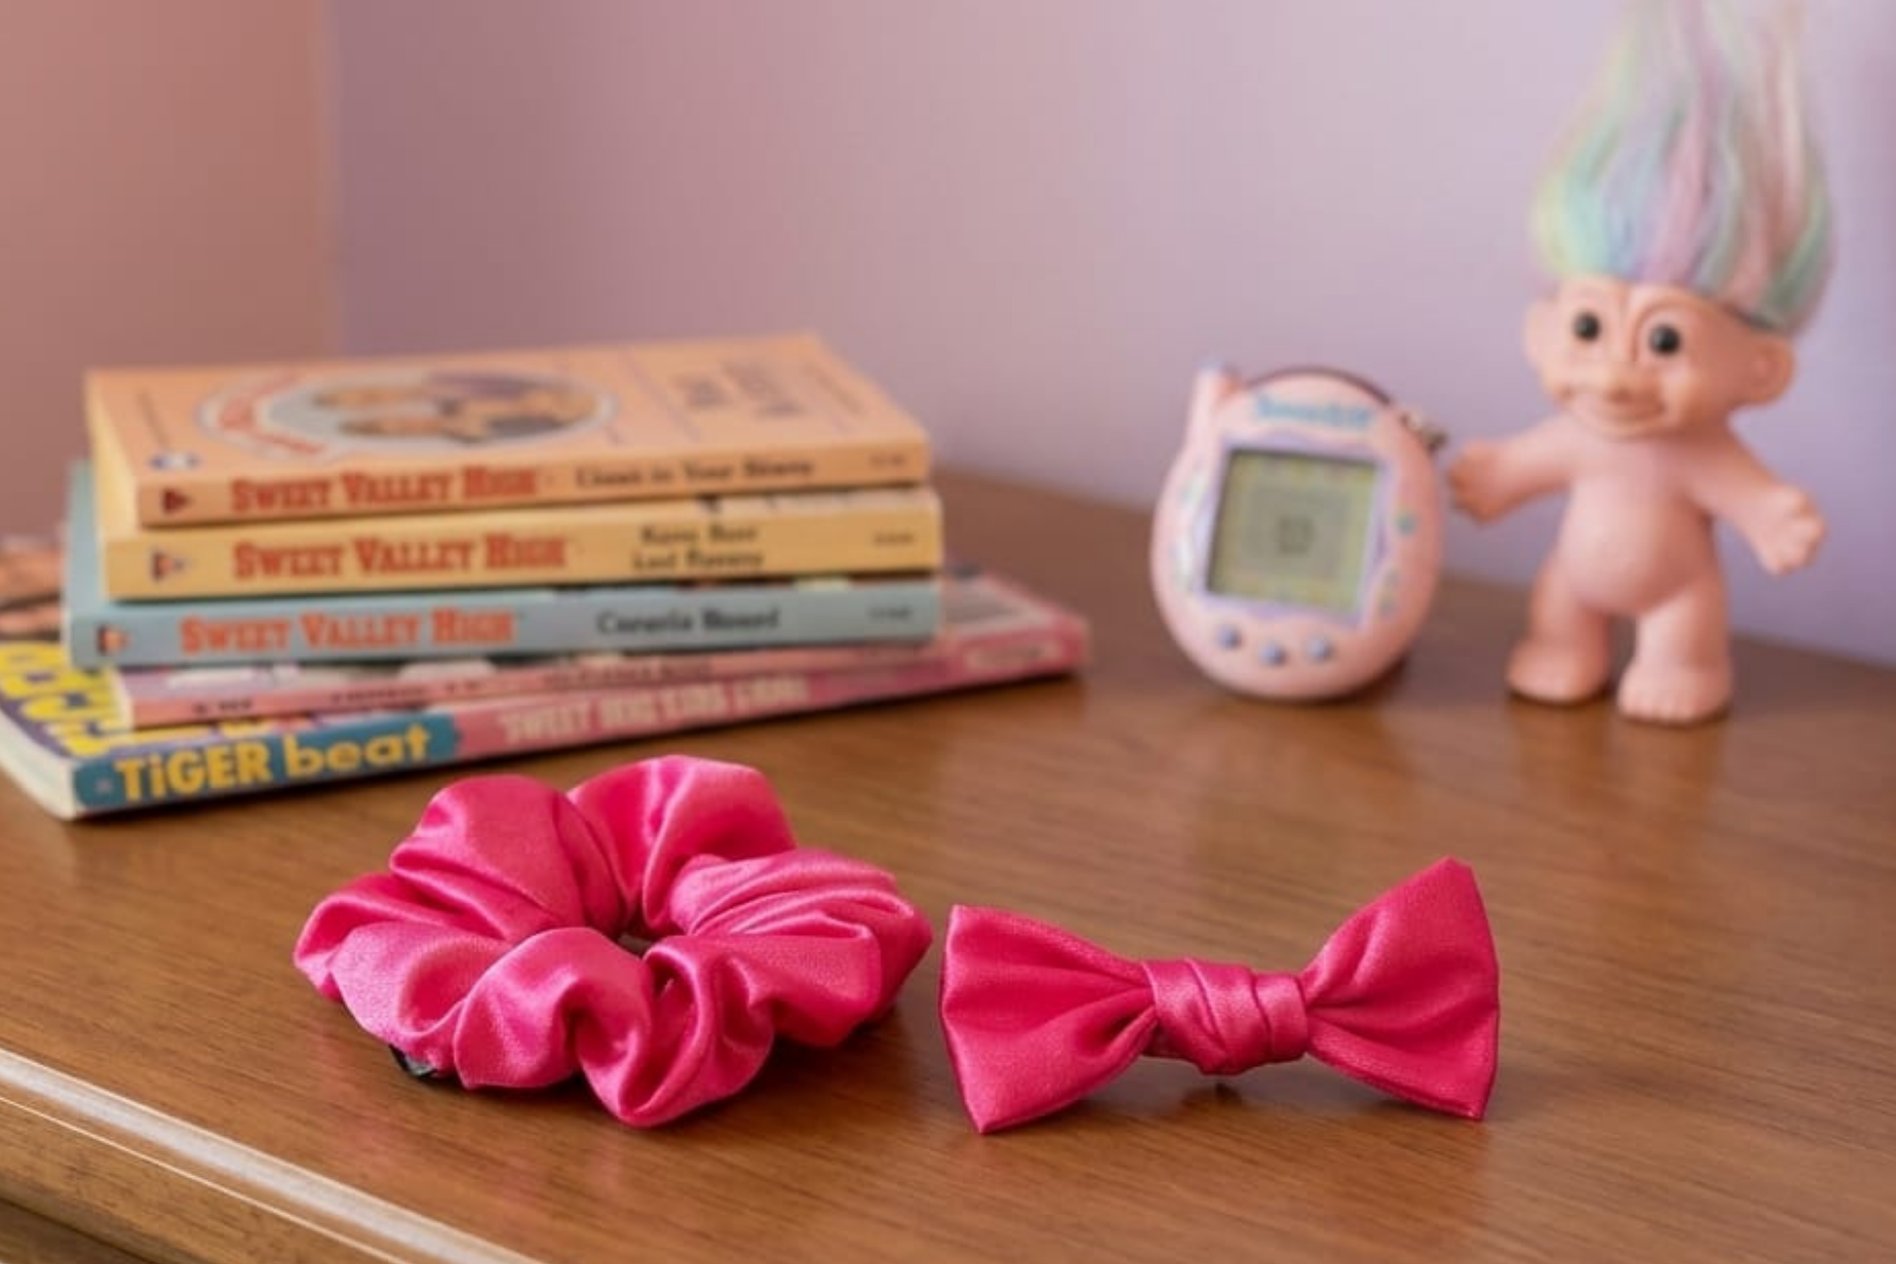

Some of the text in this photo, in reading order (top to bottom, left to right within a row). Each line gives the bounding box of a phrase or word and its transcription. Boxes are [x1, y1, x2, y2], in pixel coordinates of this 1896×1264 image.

[232, 477, 331, 512] SWEET
[342, 470, 453, 506] VALLEY
[462, 465, 537, 497] HIGH
[234, 531, 566, 580] SWEET VALLEY HIGH
[180, 607, 516, 654] SWEET VALLEY HIGH
[283, 724, 431, 777] beat
